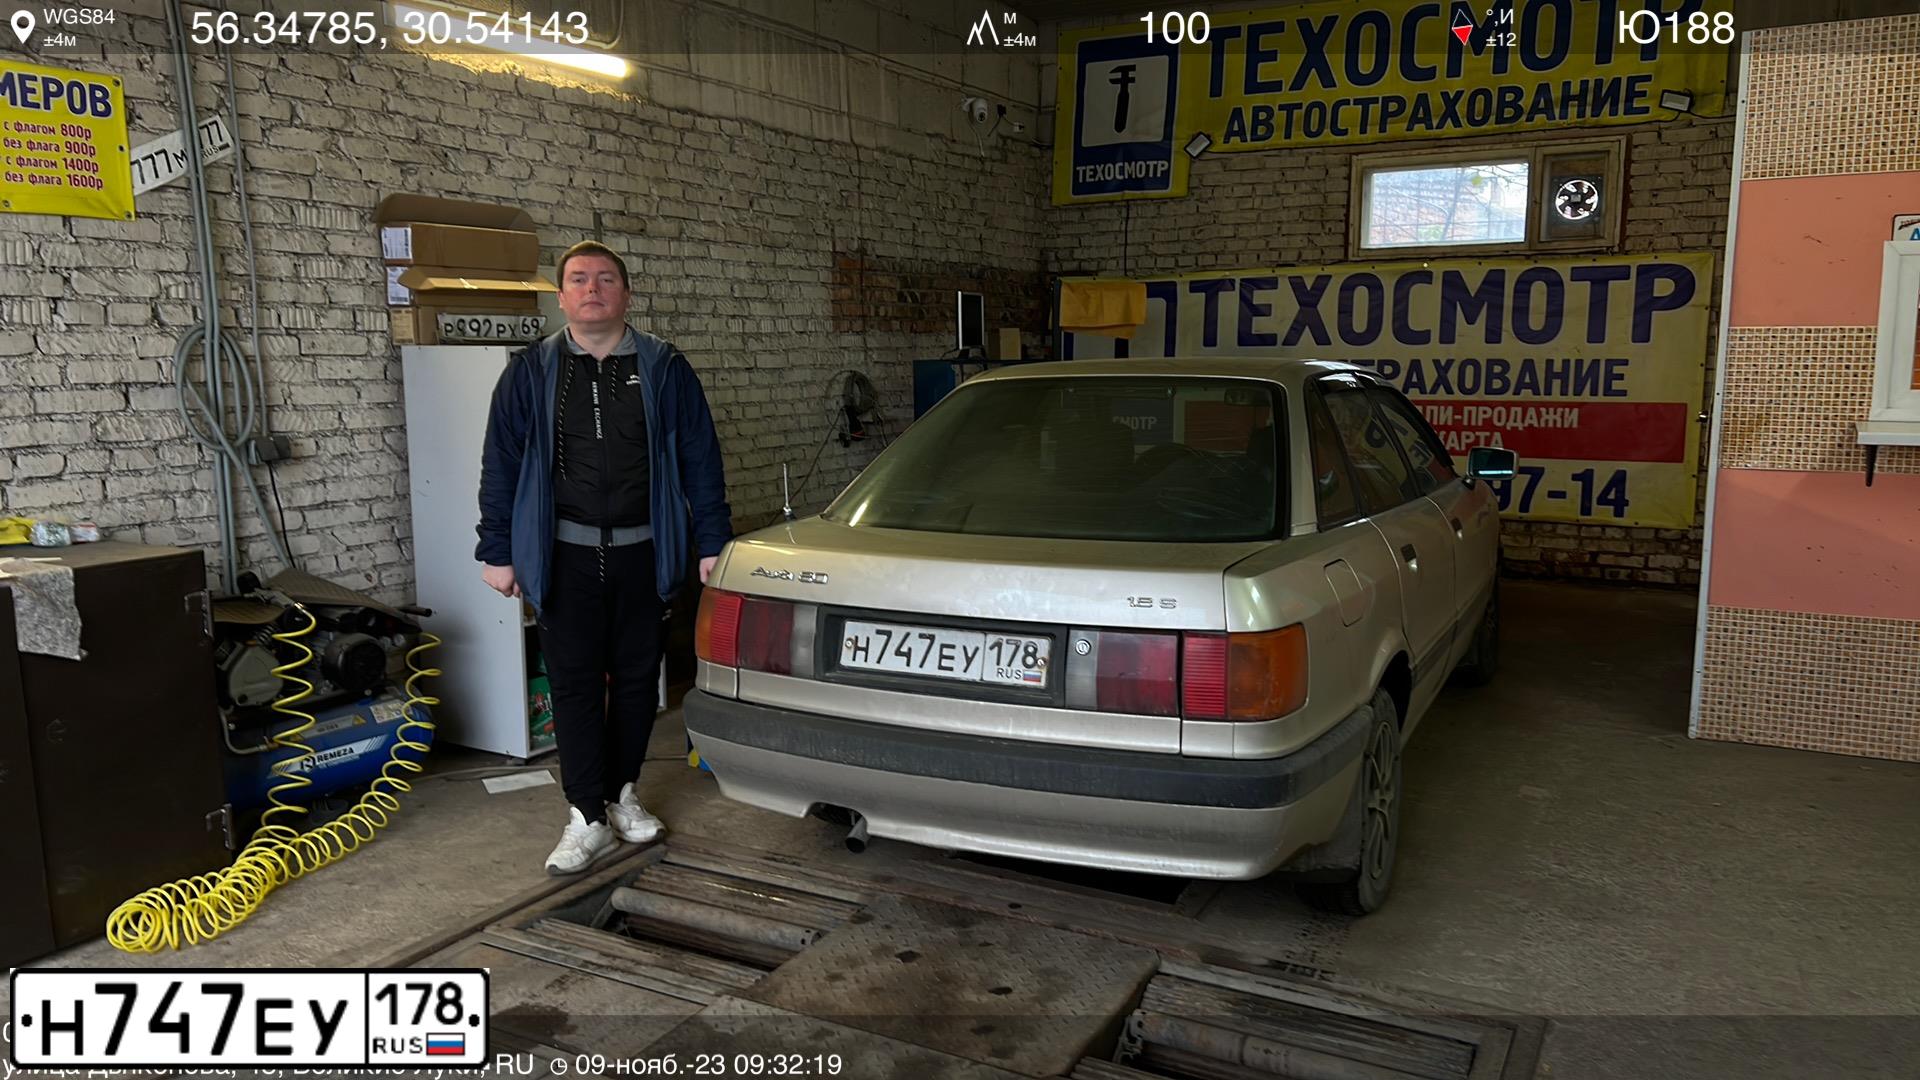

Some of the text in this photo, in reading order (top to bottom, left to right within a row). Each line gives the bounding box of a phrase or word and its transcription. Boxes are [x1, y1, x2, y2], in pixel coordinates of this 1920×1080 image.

[1197, 0, 1703, 98] ТЕХОСМОТР
[0, 71, 112, 118] МЕРОВ
[1223, 74, 1653, 144] АВТОСТРАХОВАНИЕ
[13, 120, 56, 136] флагом
[60, 123, 93, 142] 800р
[3, 138, 97, 158] без флага 900р
[16, 155, 58, 170] флагом
[62, 157, 99, 175] 1400р
[1076, 160, 1169, 184] ТЕХОСМОТР
[4, 171, 104, 190] без флага 1600р
[1188, 263, 1697, 348] ТЕХОСМОТР
[1418, 405, 1579, 431] ЛИ-ПРОДАЖИ
[989, 637, 1039, 669] 178
[996, 667, 1023, 680] RUS
[316, 746, 355, 763] REMEZA
